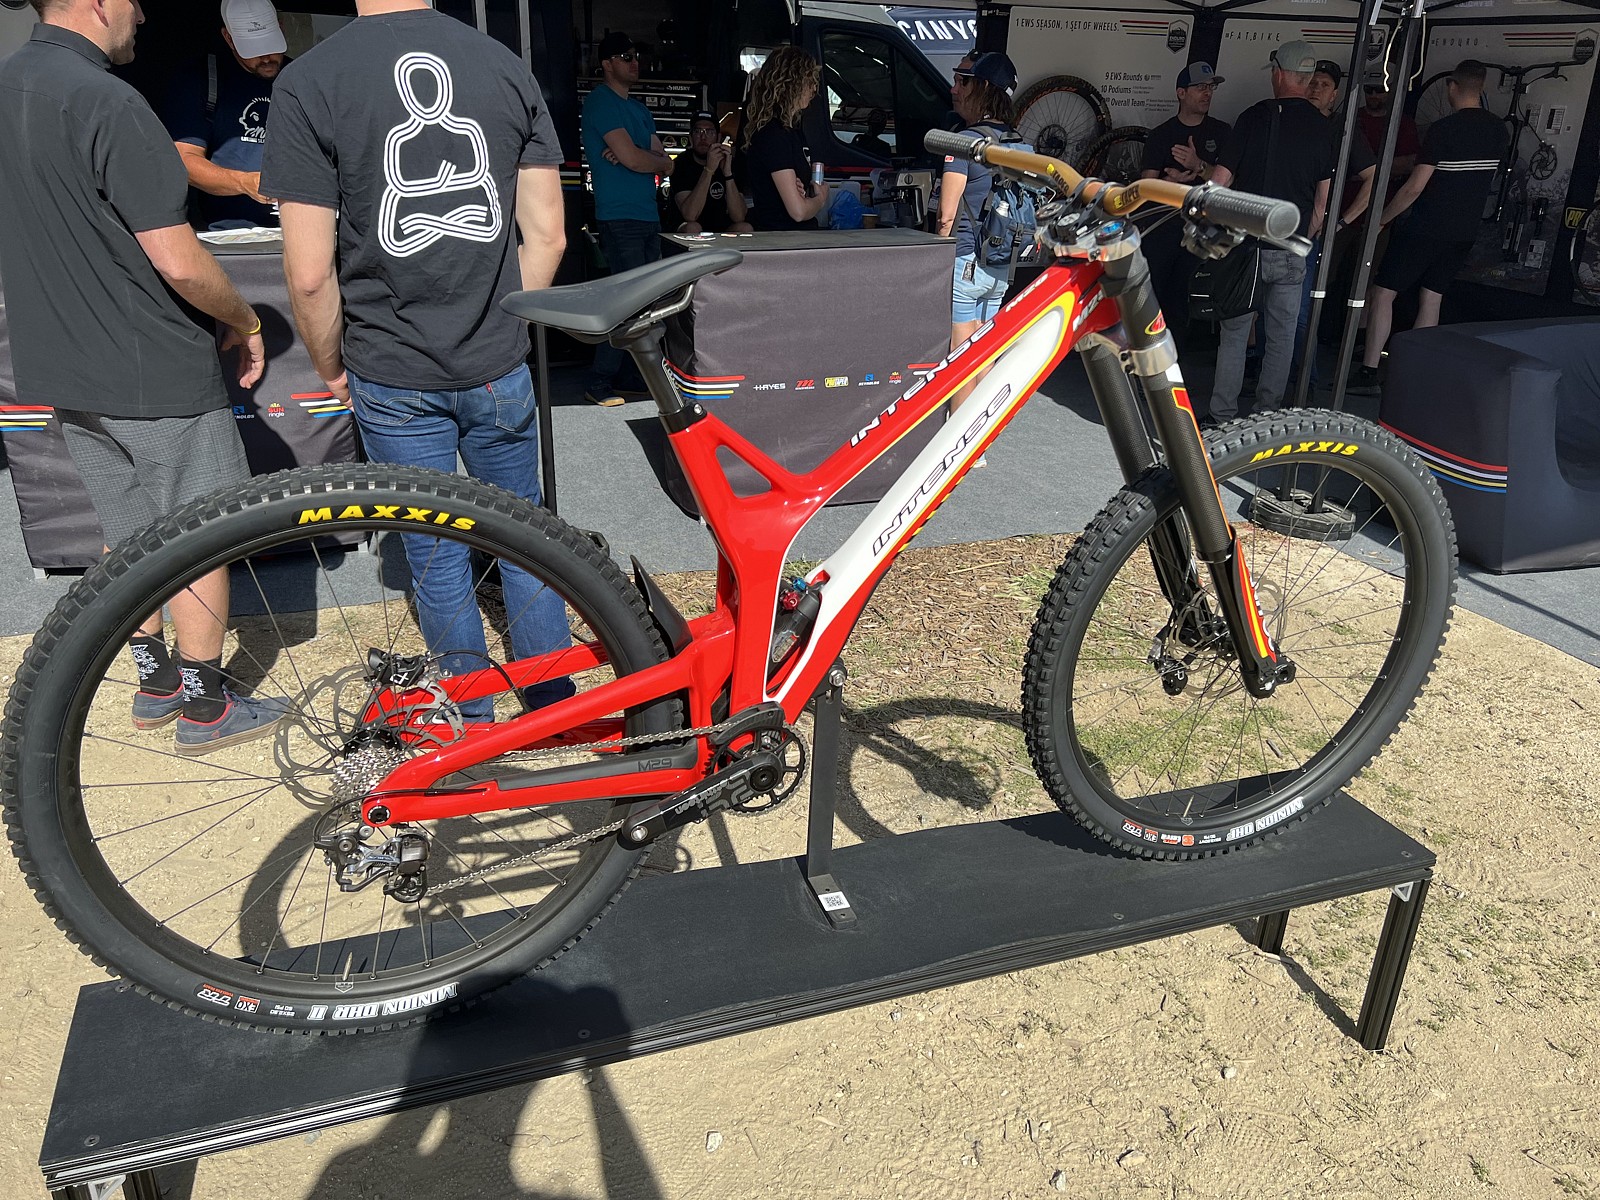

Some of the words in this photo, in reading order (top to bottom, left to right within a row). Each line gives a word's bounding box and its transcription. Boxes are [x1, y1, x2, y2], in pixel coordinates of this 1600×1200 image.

[1021, 18, 1034, 27] EWS
[1070, 21, 1081, 30] SET
[1083, 21, 1091, 30] OF
[1110, 72, 1122, 80] EWS
[1122, 73, 1143, 82] Rounds
[1101, 85, 1107, 93] 10
[1108, 85, 1132, 94] Podiums
[1110, 98, 1131, 107] Overall
[1131, 99, 1145, 107] Team
[849, 319, 996, 447] INTENSE
[1249, 441, 1359, 463] MAXXIS
[872, 383, 1011, 557] INTENSE
[298, 505, 476, 530] MAXXIS
[1255, 797, 1304, 833] MINION
[236, 1000, 257, 1012] EXO
[381, 981, 459, 1016] MINION
[332, 1003, 379, 1020] DHR
